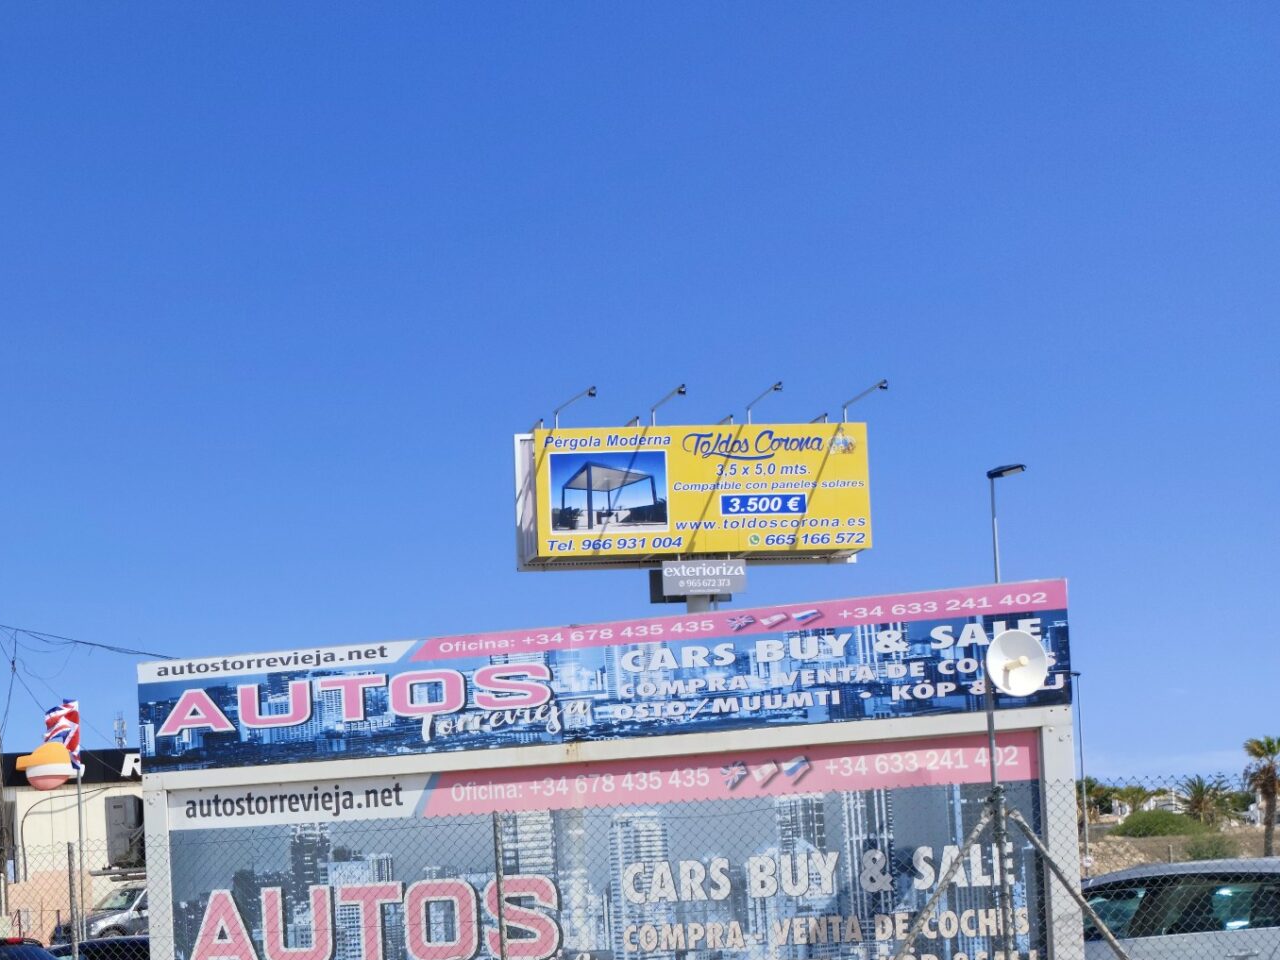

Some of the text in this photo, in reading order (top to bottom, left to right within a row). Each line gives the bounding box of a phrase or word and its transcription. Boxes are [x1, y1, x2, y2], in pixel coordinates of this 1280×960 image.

[544, 434, 671, 450] Pérgola Moderna
[682, 429, 824, 459] Toldos Corona
[673, 479, 865, 492] Compatible con paneles solares
[716, 463, 811, 477] 3,5 x 5,0 mts.
[728, 496, 801, 513] 3.500 €
[675, 517, 866, 530] www.toldoscorona.es
[764, 532, 865, 546] 665 166 572
[547, 536, 683, 551] Tel. 966 931 004
[663, 562, 745, 577] exterioriza
[837, 592, 1048, 620] +34 633 241 402
[439, 619, 715, 654] Oficina: +34 678 435 435
[621, 642, 737, 673] CARS
[755, 632, 853, 664] BUY
[874, 630, 911, 653] &
[157, 644, 388, 678] autostorrevieja.net
[620, 675, 750, 699] COMPRA
[783, 665, 875, 688] VENTA
[887, 661, 925, 679] DE
[891, 680, 957, 701] KÖP
[156, 662, 556, 737] AUTOS
[420, 699, 594, 743] Torrevieja
[825, 745, 1019, 777] +34 633 241 402
[450, 766, 710, 802] Oficina: +34 678 435 435
[185, 782, 404, 819] autostorrevieja.net
[622, 841, 1016, 905] CARS BUY & SALE
[622, 919, 747, 954] COMPRA
[773, 912, 863, 947] VENTA
[874, 911, 910, 941] DE
